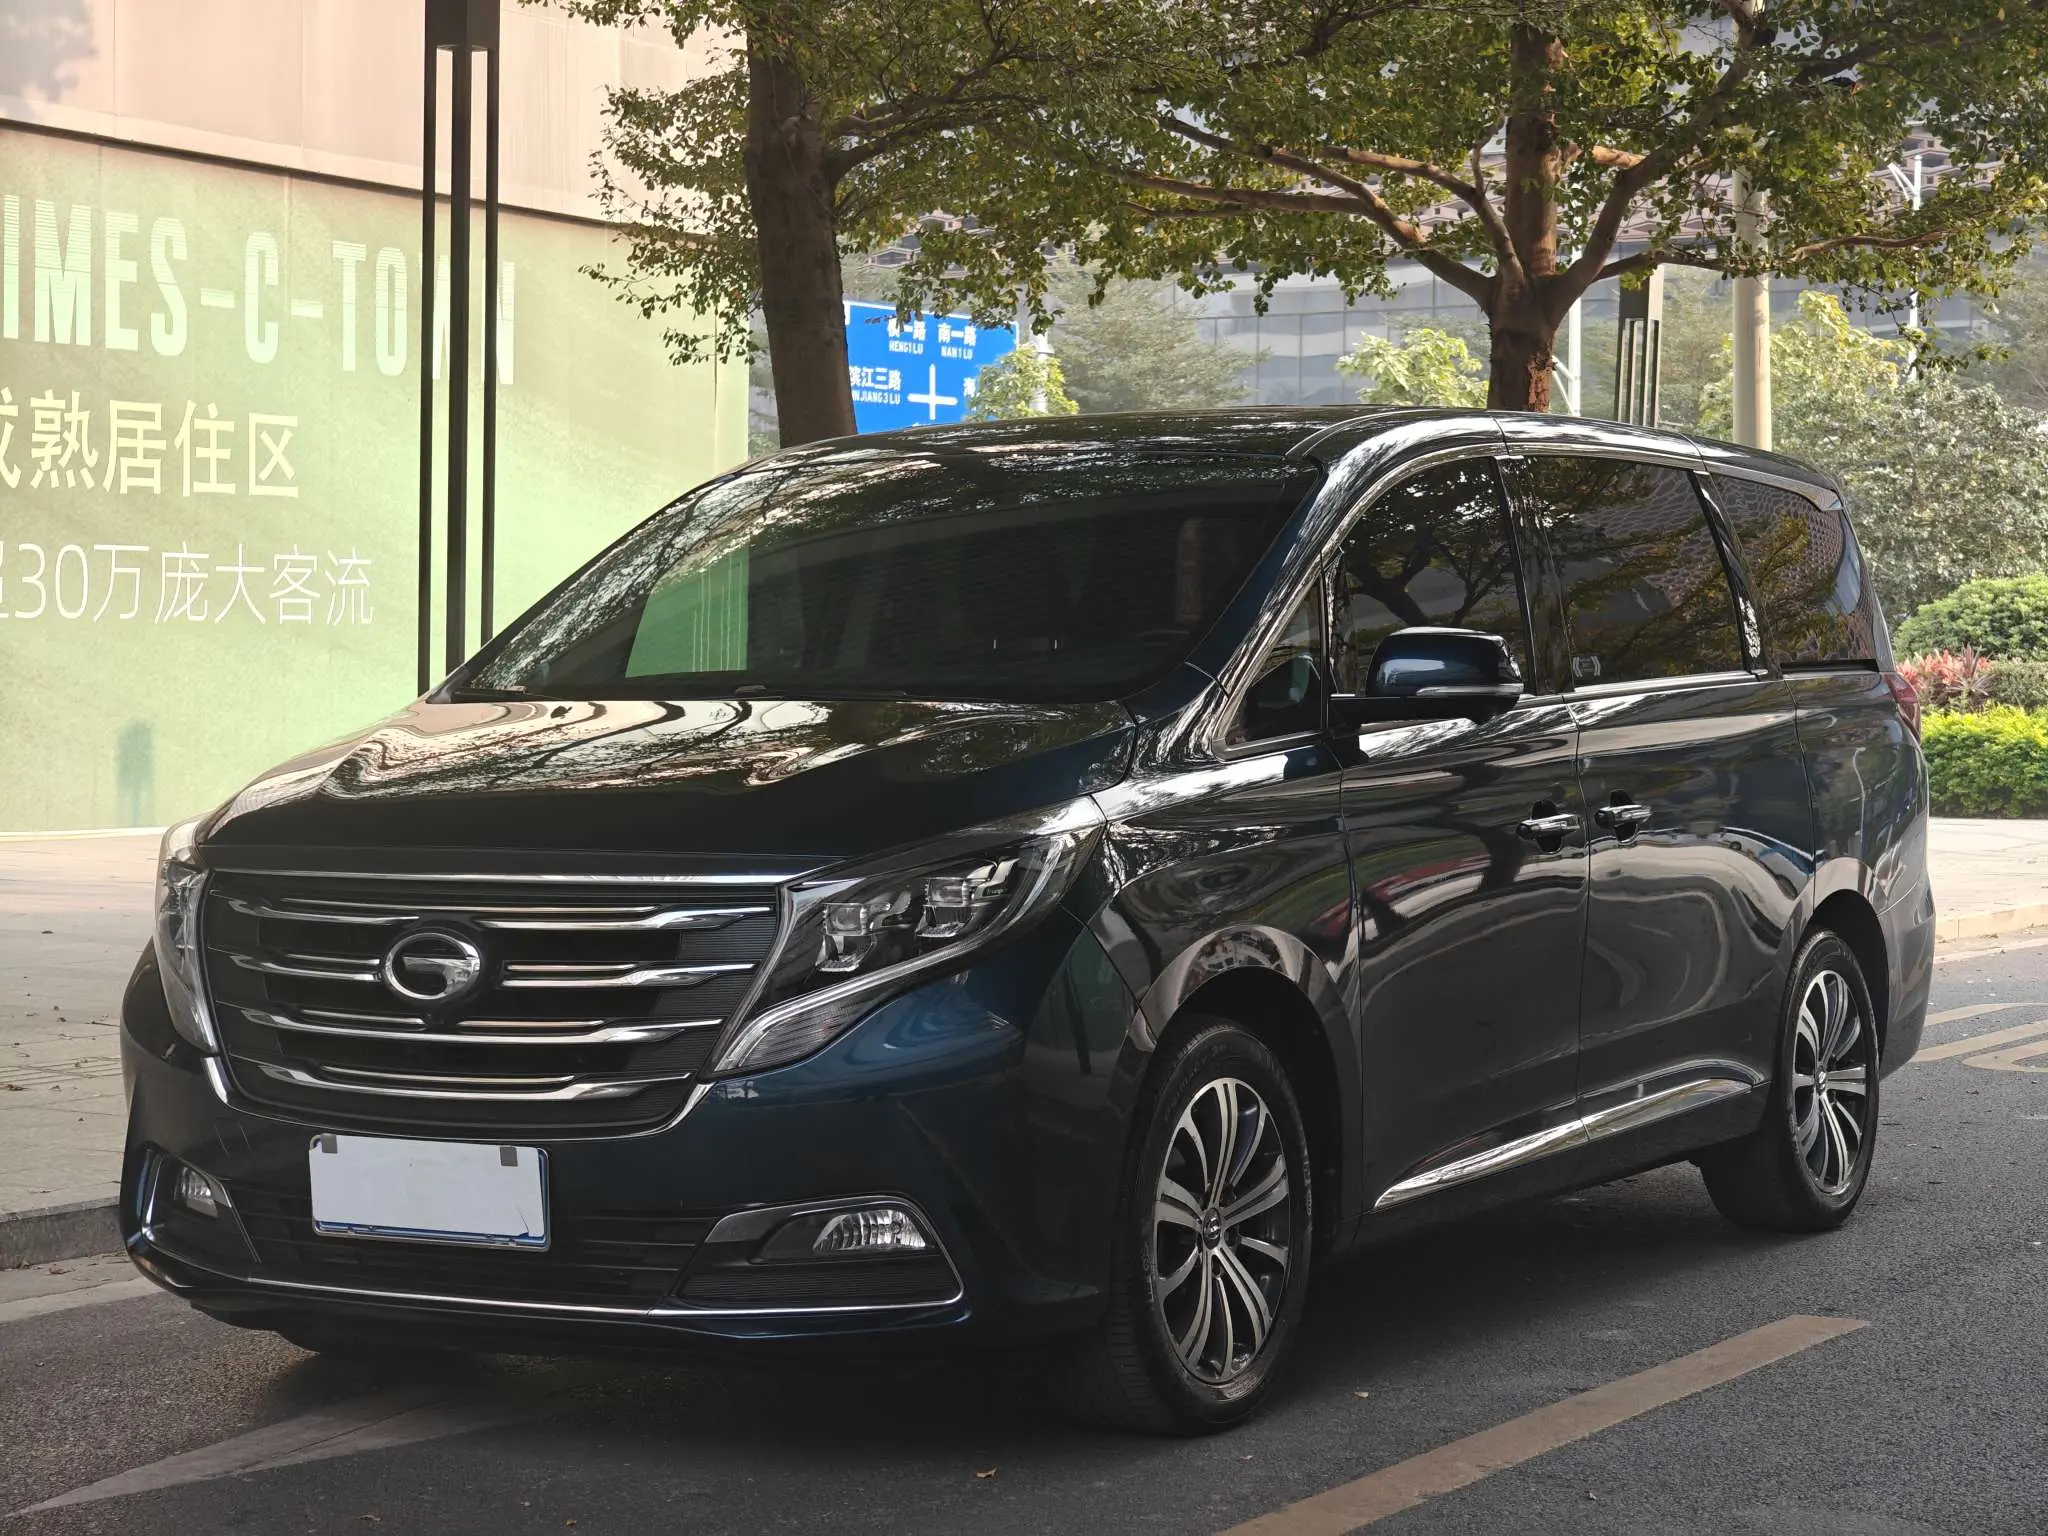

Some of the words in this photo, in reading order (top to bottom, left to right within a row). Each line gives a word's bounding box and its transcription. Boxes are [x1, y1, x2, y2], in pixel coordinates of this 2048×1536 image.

[0, 541, 374, 626] 30万庞大客流
